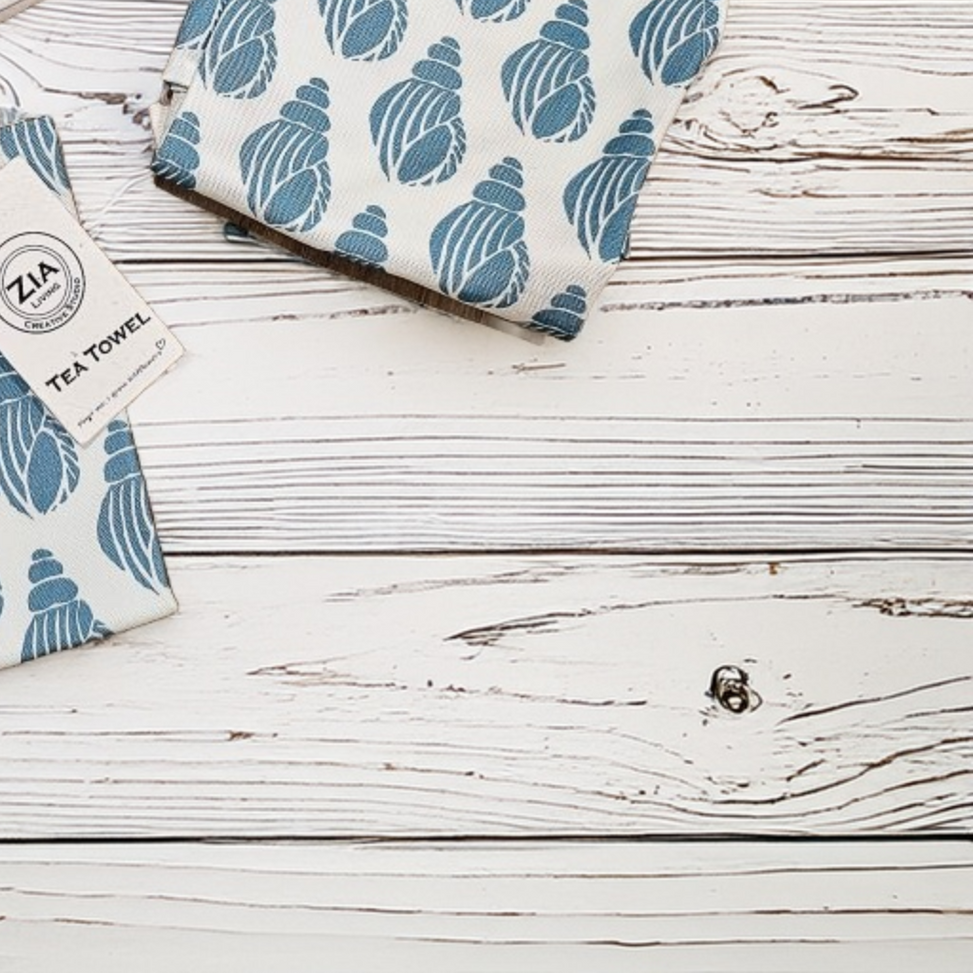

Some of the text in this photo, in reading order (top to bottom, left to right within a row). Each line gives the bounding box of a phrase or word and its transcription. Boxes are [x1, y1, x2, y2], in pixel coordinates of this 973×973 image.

[6, 260, 60, 305] ZIA
[45, 312, 152, 392] TEA TOWEL
